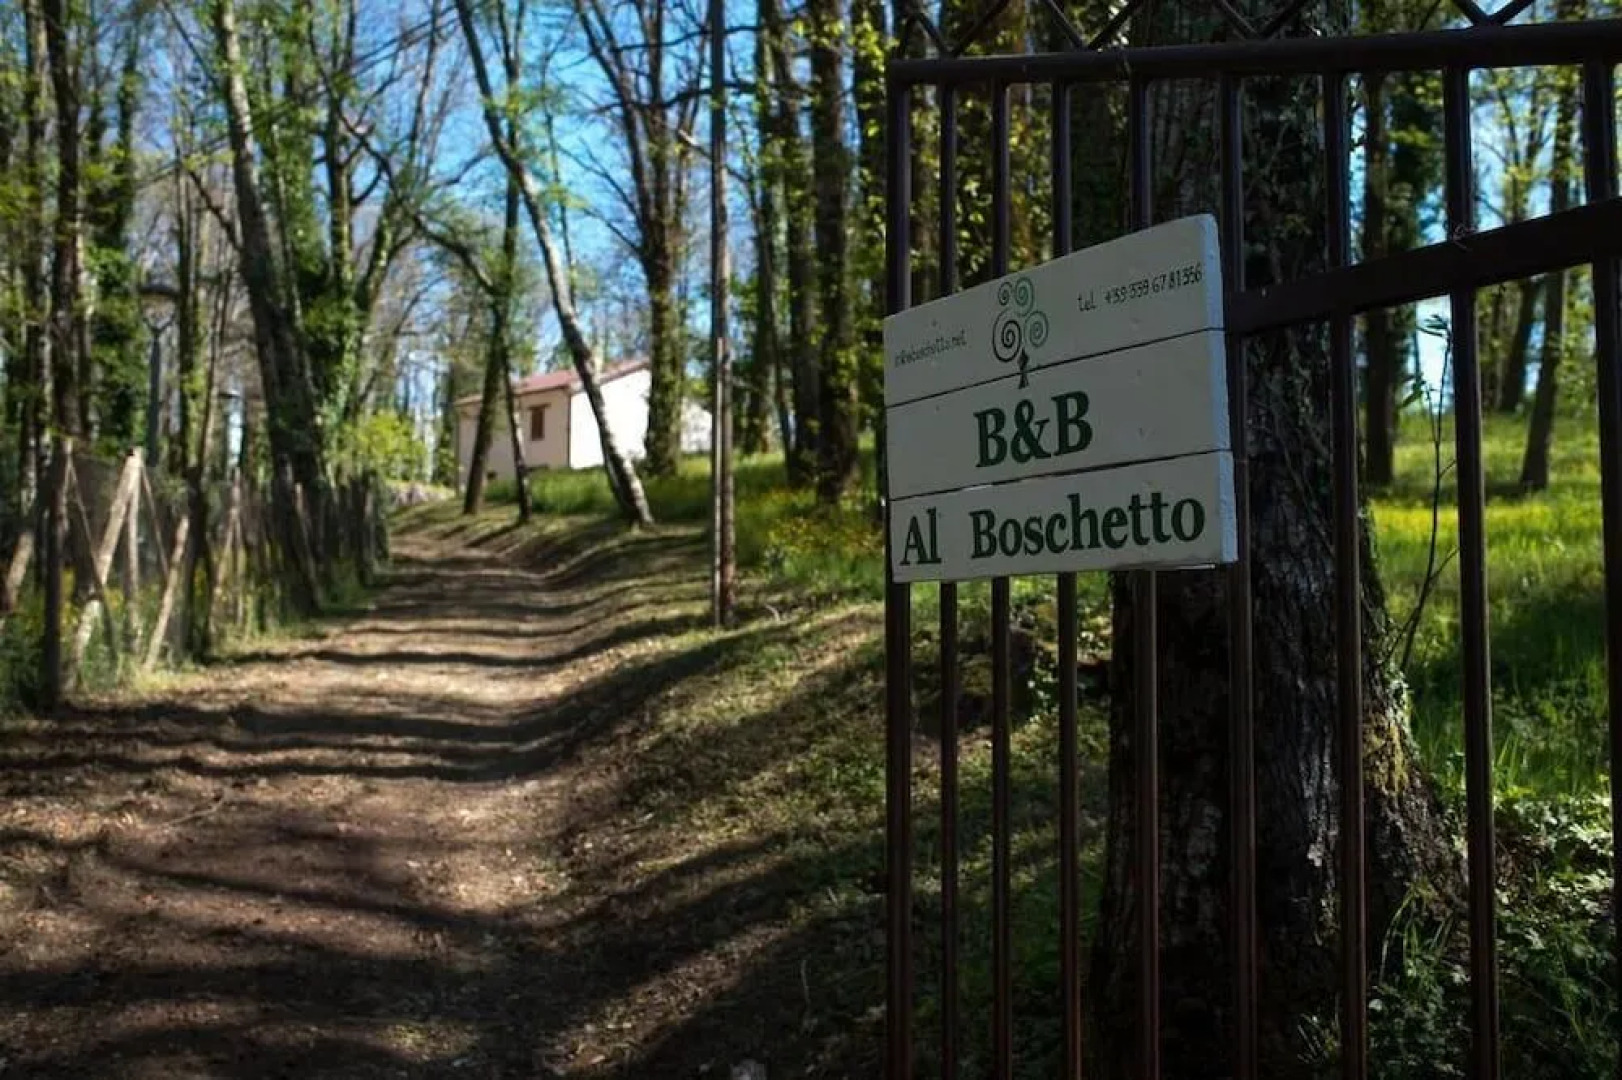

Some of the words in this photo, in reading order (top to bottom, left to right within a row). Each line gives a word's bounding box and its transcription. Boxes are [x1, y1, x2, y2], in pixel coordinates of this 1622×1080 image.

[973, 390, 1093, 468] B&B
[900, 507, 942, 566] Al
[969, 492, 1206, 559] Boschetto
